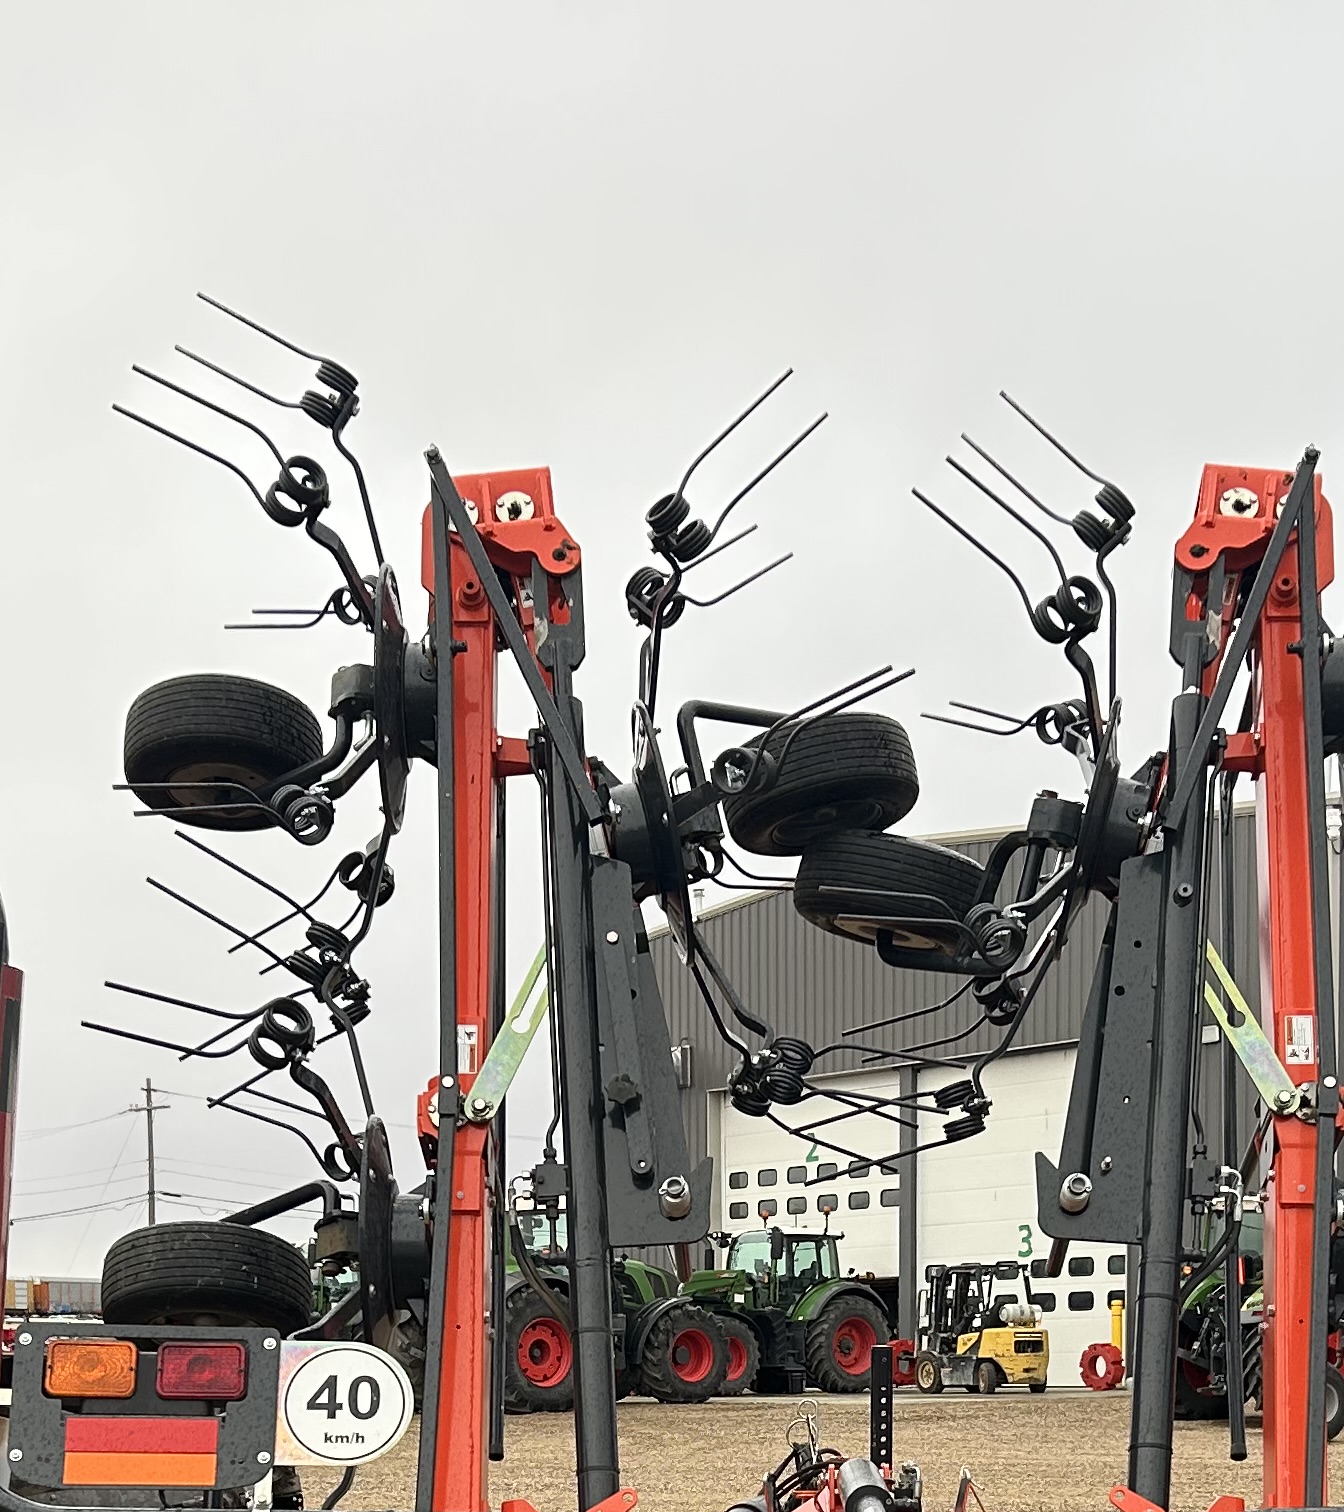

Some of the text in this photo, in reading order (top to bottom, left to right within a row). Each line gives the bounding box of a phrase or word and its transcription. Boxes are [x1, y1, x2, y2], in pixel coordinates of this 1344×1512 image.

[1018, 1224, 1033, 1258] 3
[306, 1374, 381, 1420] 40
[323, 1432, 365, 1444] km/h
